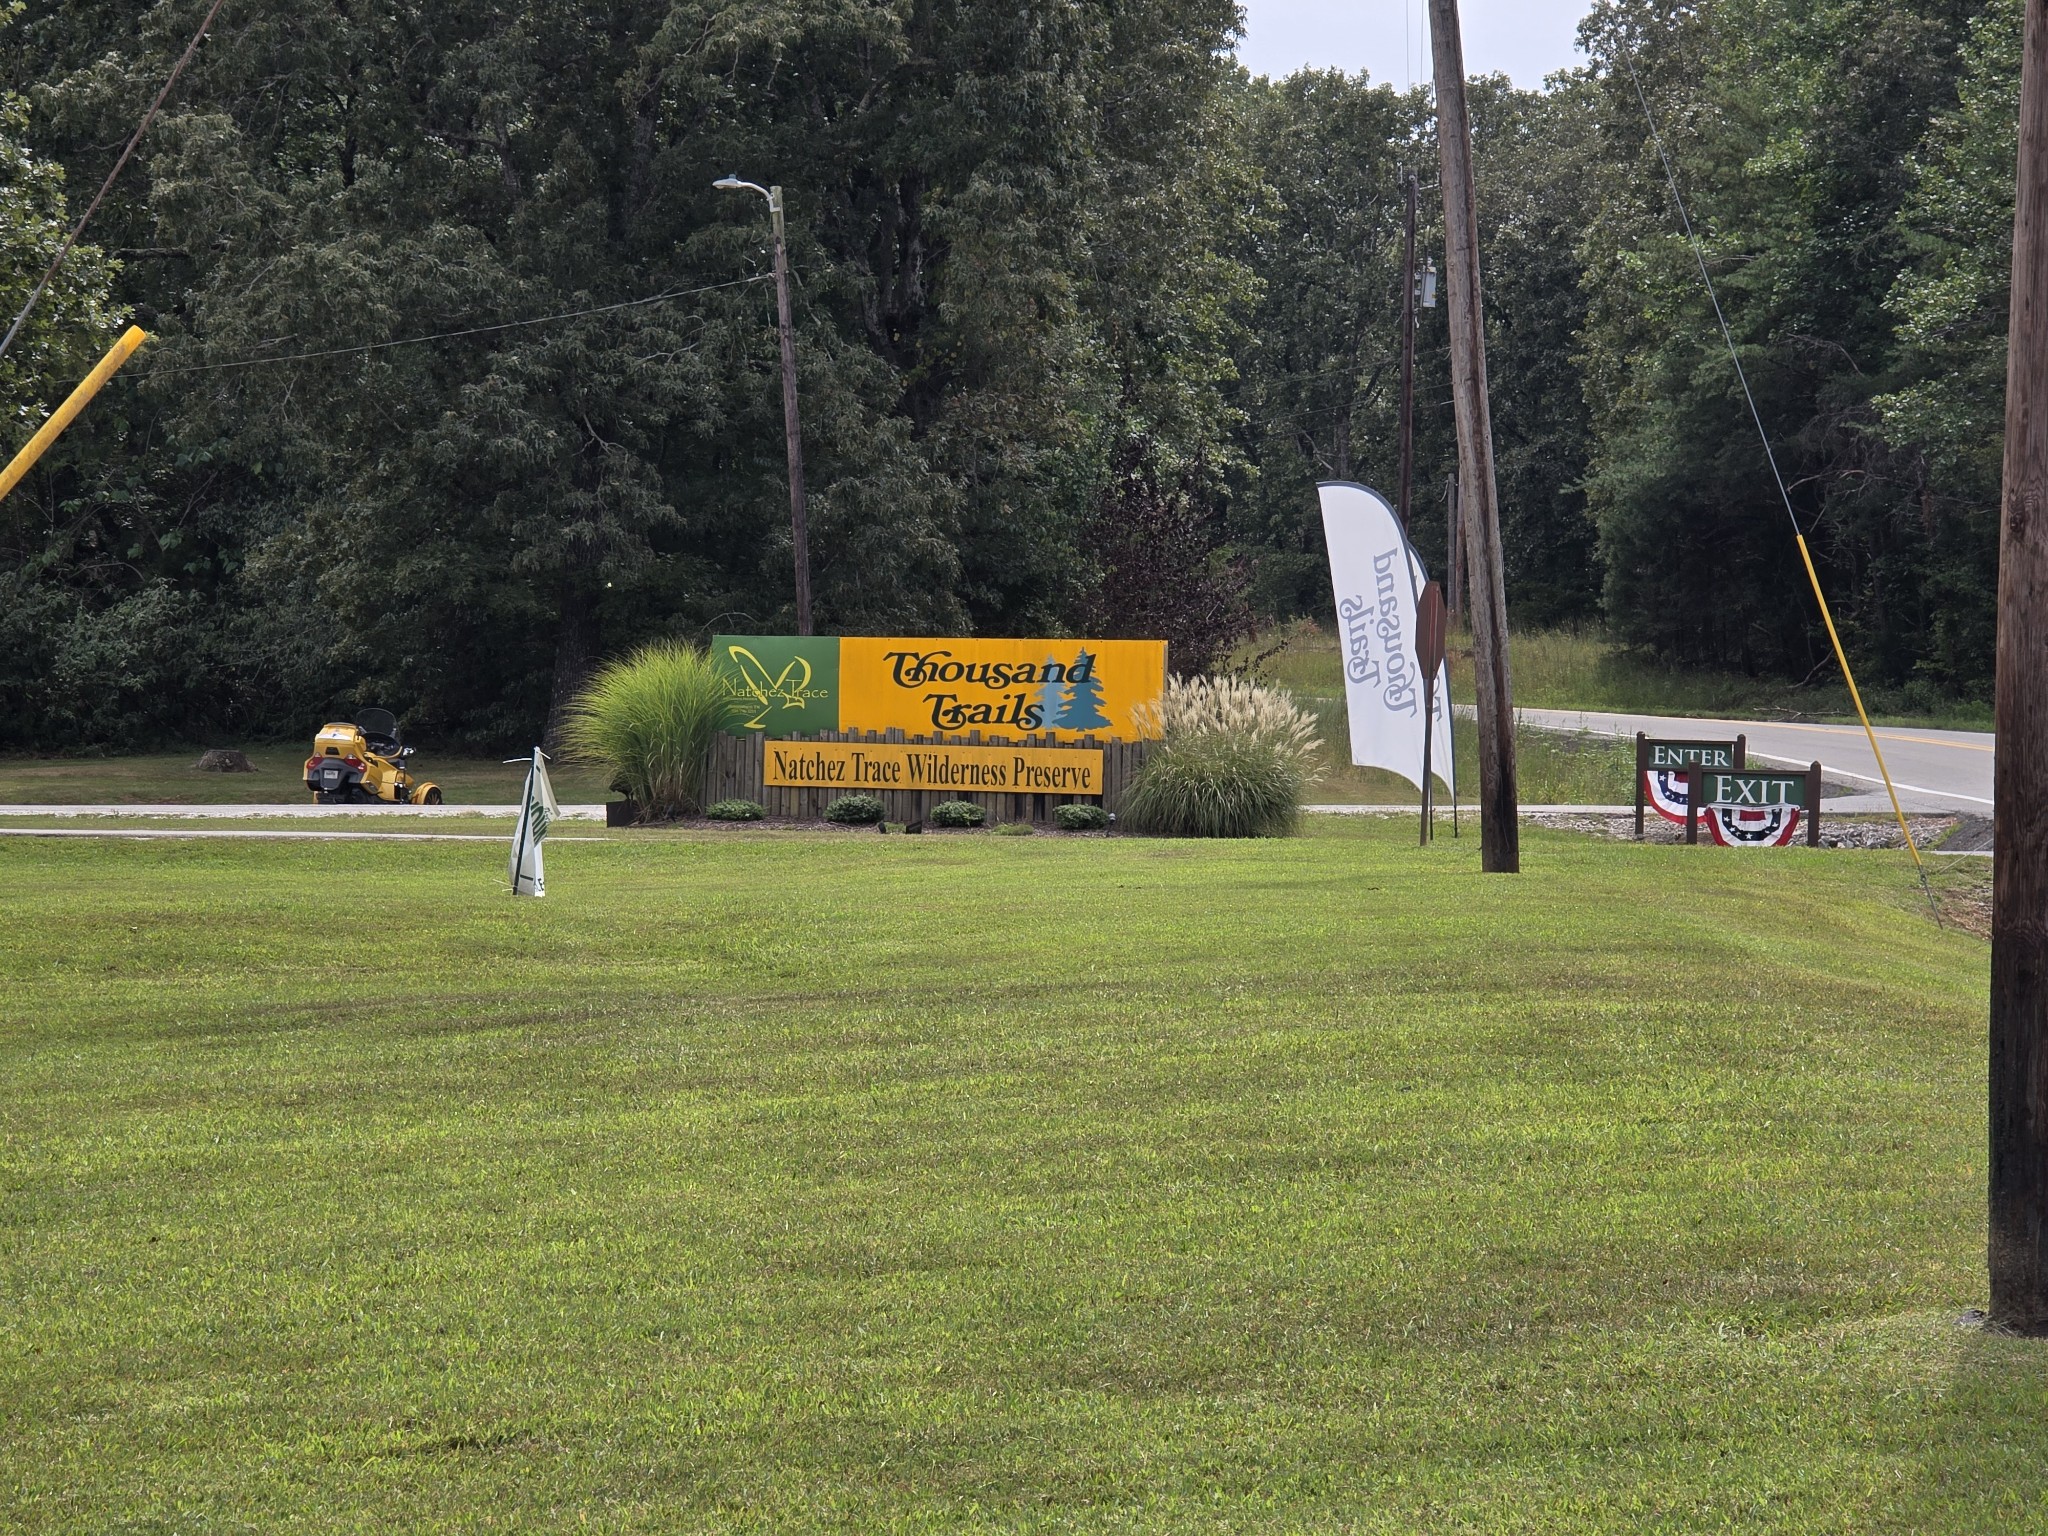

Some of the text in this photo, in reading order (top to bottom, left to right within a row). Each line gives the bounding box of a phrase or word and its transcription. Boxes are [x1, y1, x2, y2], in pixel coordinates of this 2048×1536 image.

[883, 650, 1097, 689] Thousand
[722, 677, 829, 698] Natchez Trace
[923, 692, 1045, 731] Trails
[773, 750, 1091, 789] Natchez Trace Wilderness Preserve
[1653, 745, 1730, 767] ENTER
[1714, 774, 1795, 804] EXIT
